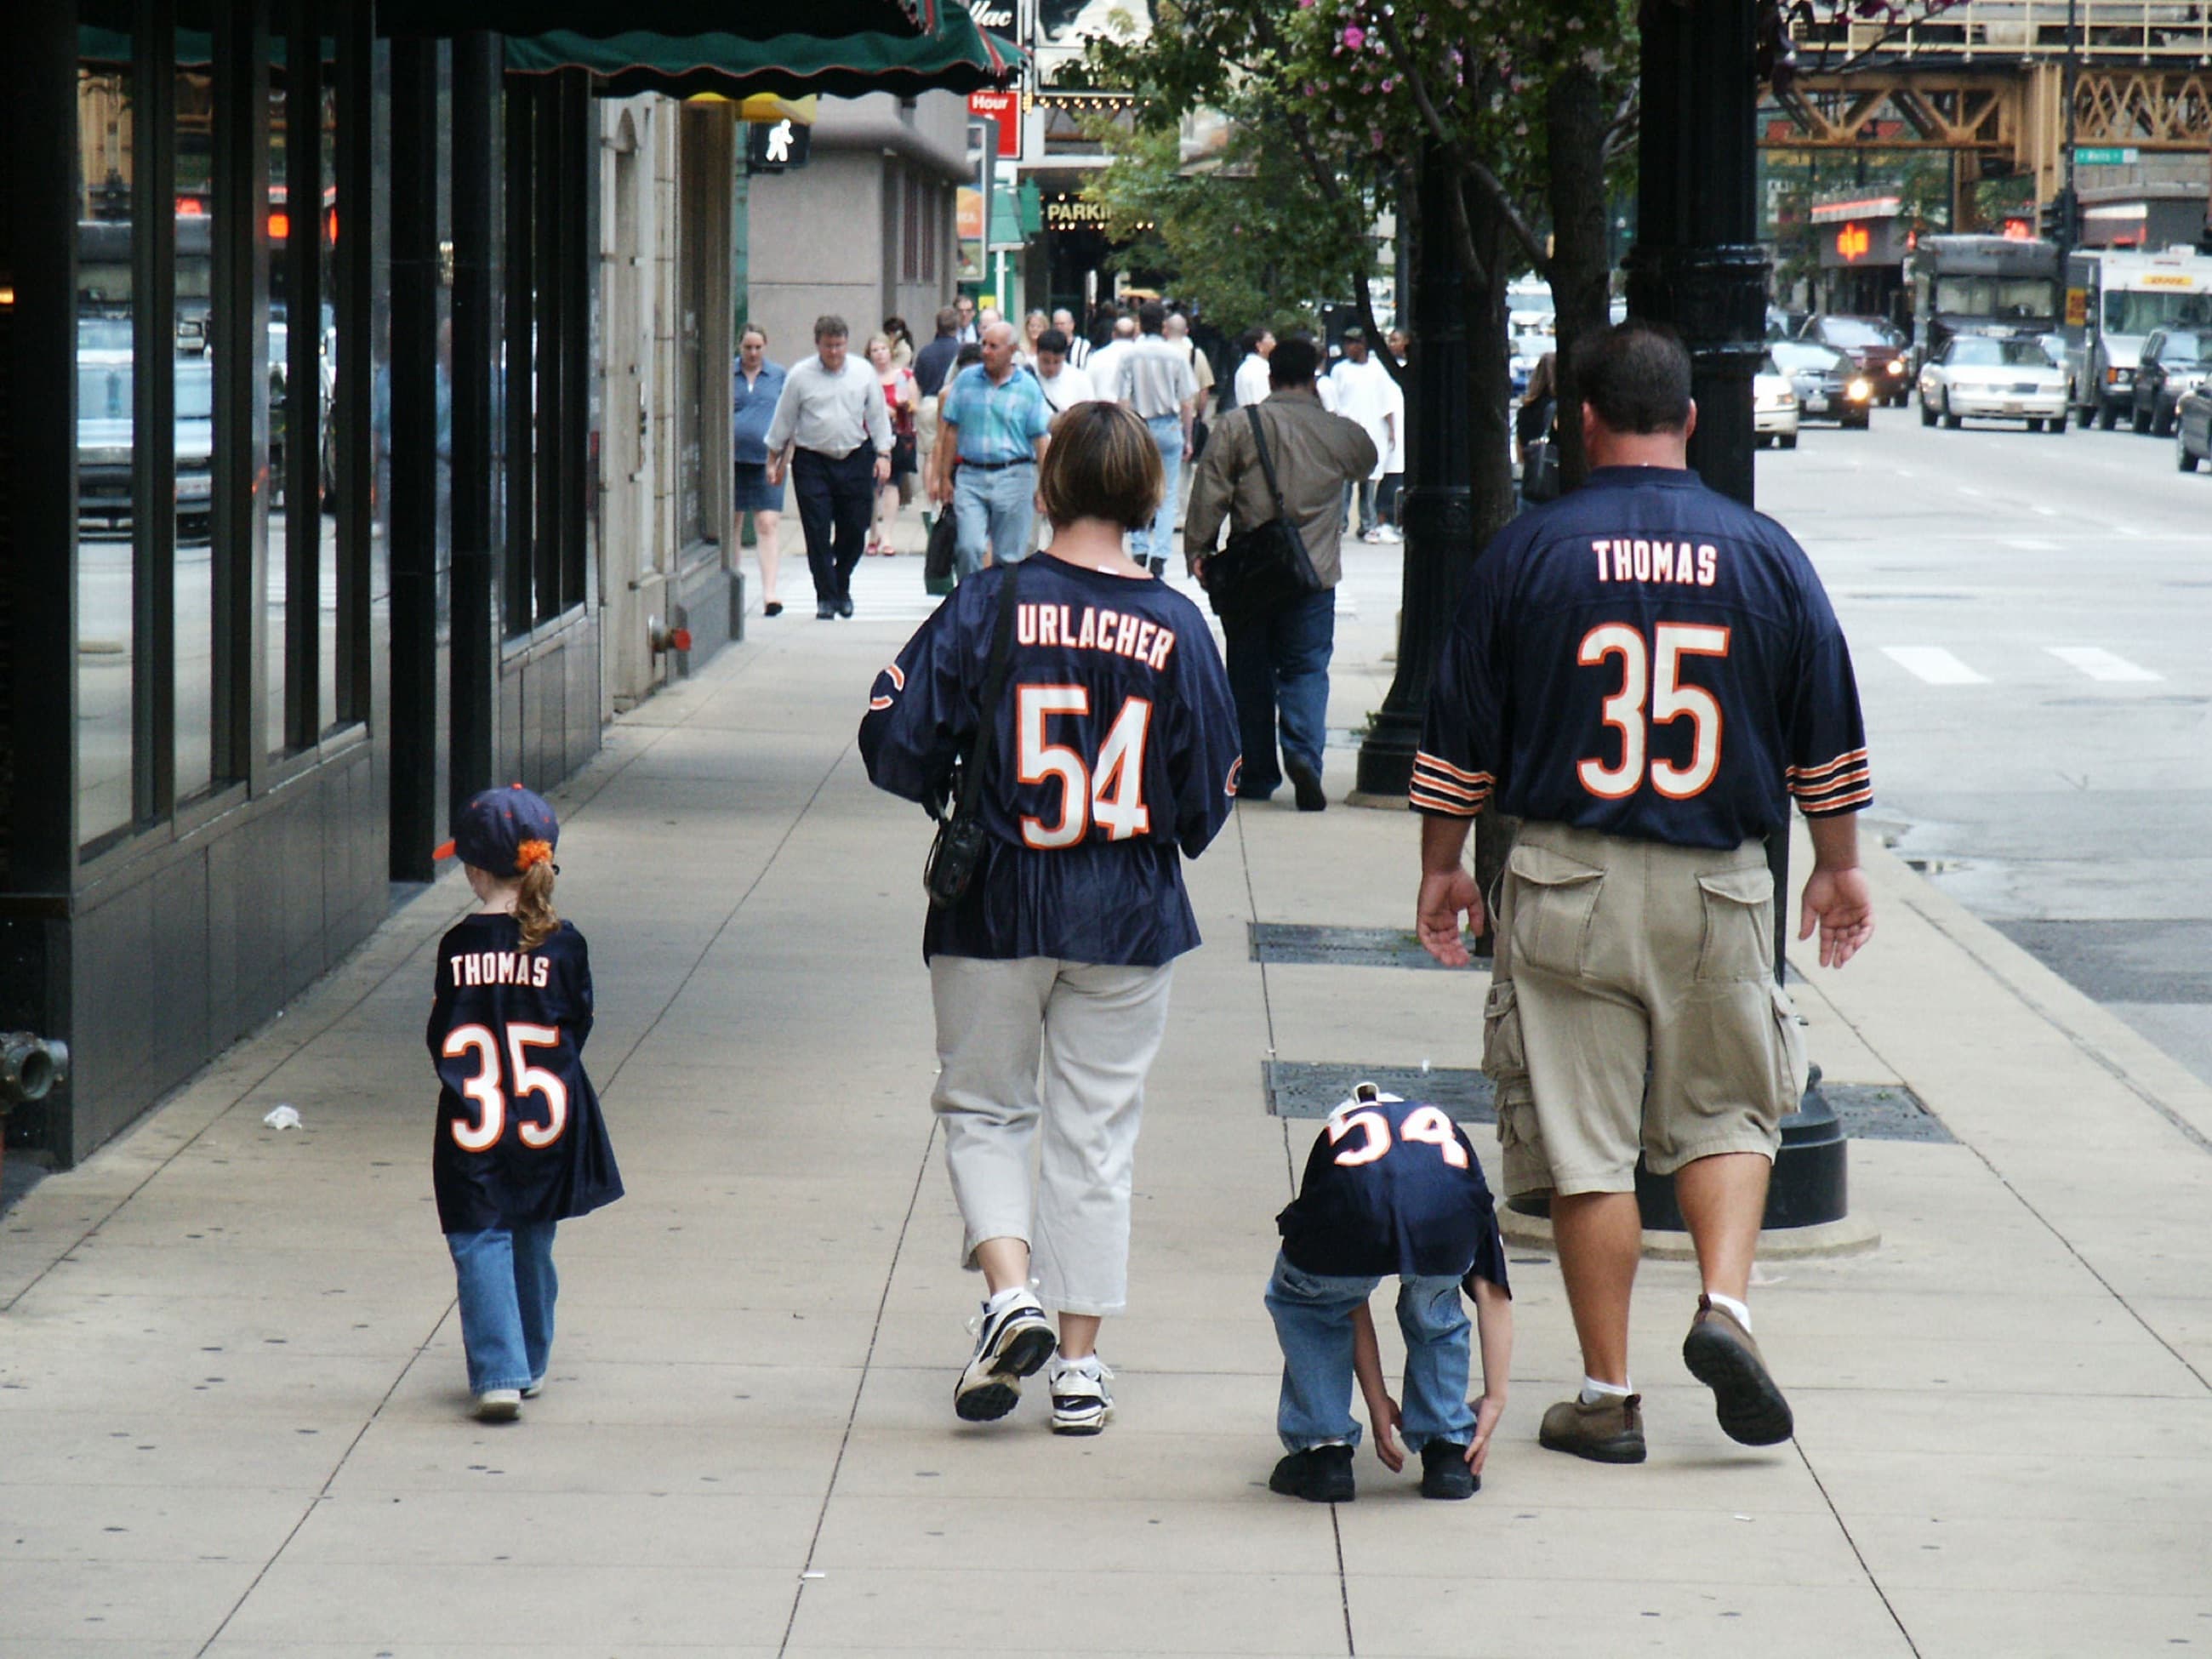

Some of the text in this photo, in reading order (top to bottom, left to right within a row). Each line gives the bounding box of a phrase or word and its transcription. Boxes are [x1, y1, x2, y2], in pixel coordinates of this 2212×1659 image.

[972, 95, 1009, 110] Hour
[1592, 539, 1717, 586] THOMAS
[1017, 603, 1175, 672] URLACHER
[1576, 621, 1730, 800] 35
[1016, 683, 1154, 850] 54
[450, 952, 550, 988] THOMAS
[442, 1022, 567, 1153] 35
[1325, 1102, 1470, 1170] 54
